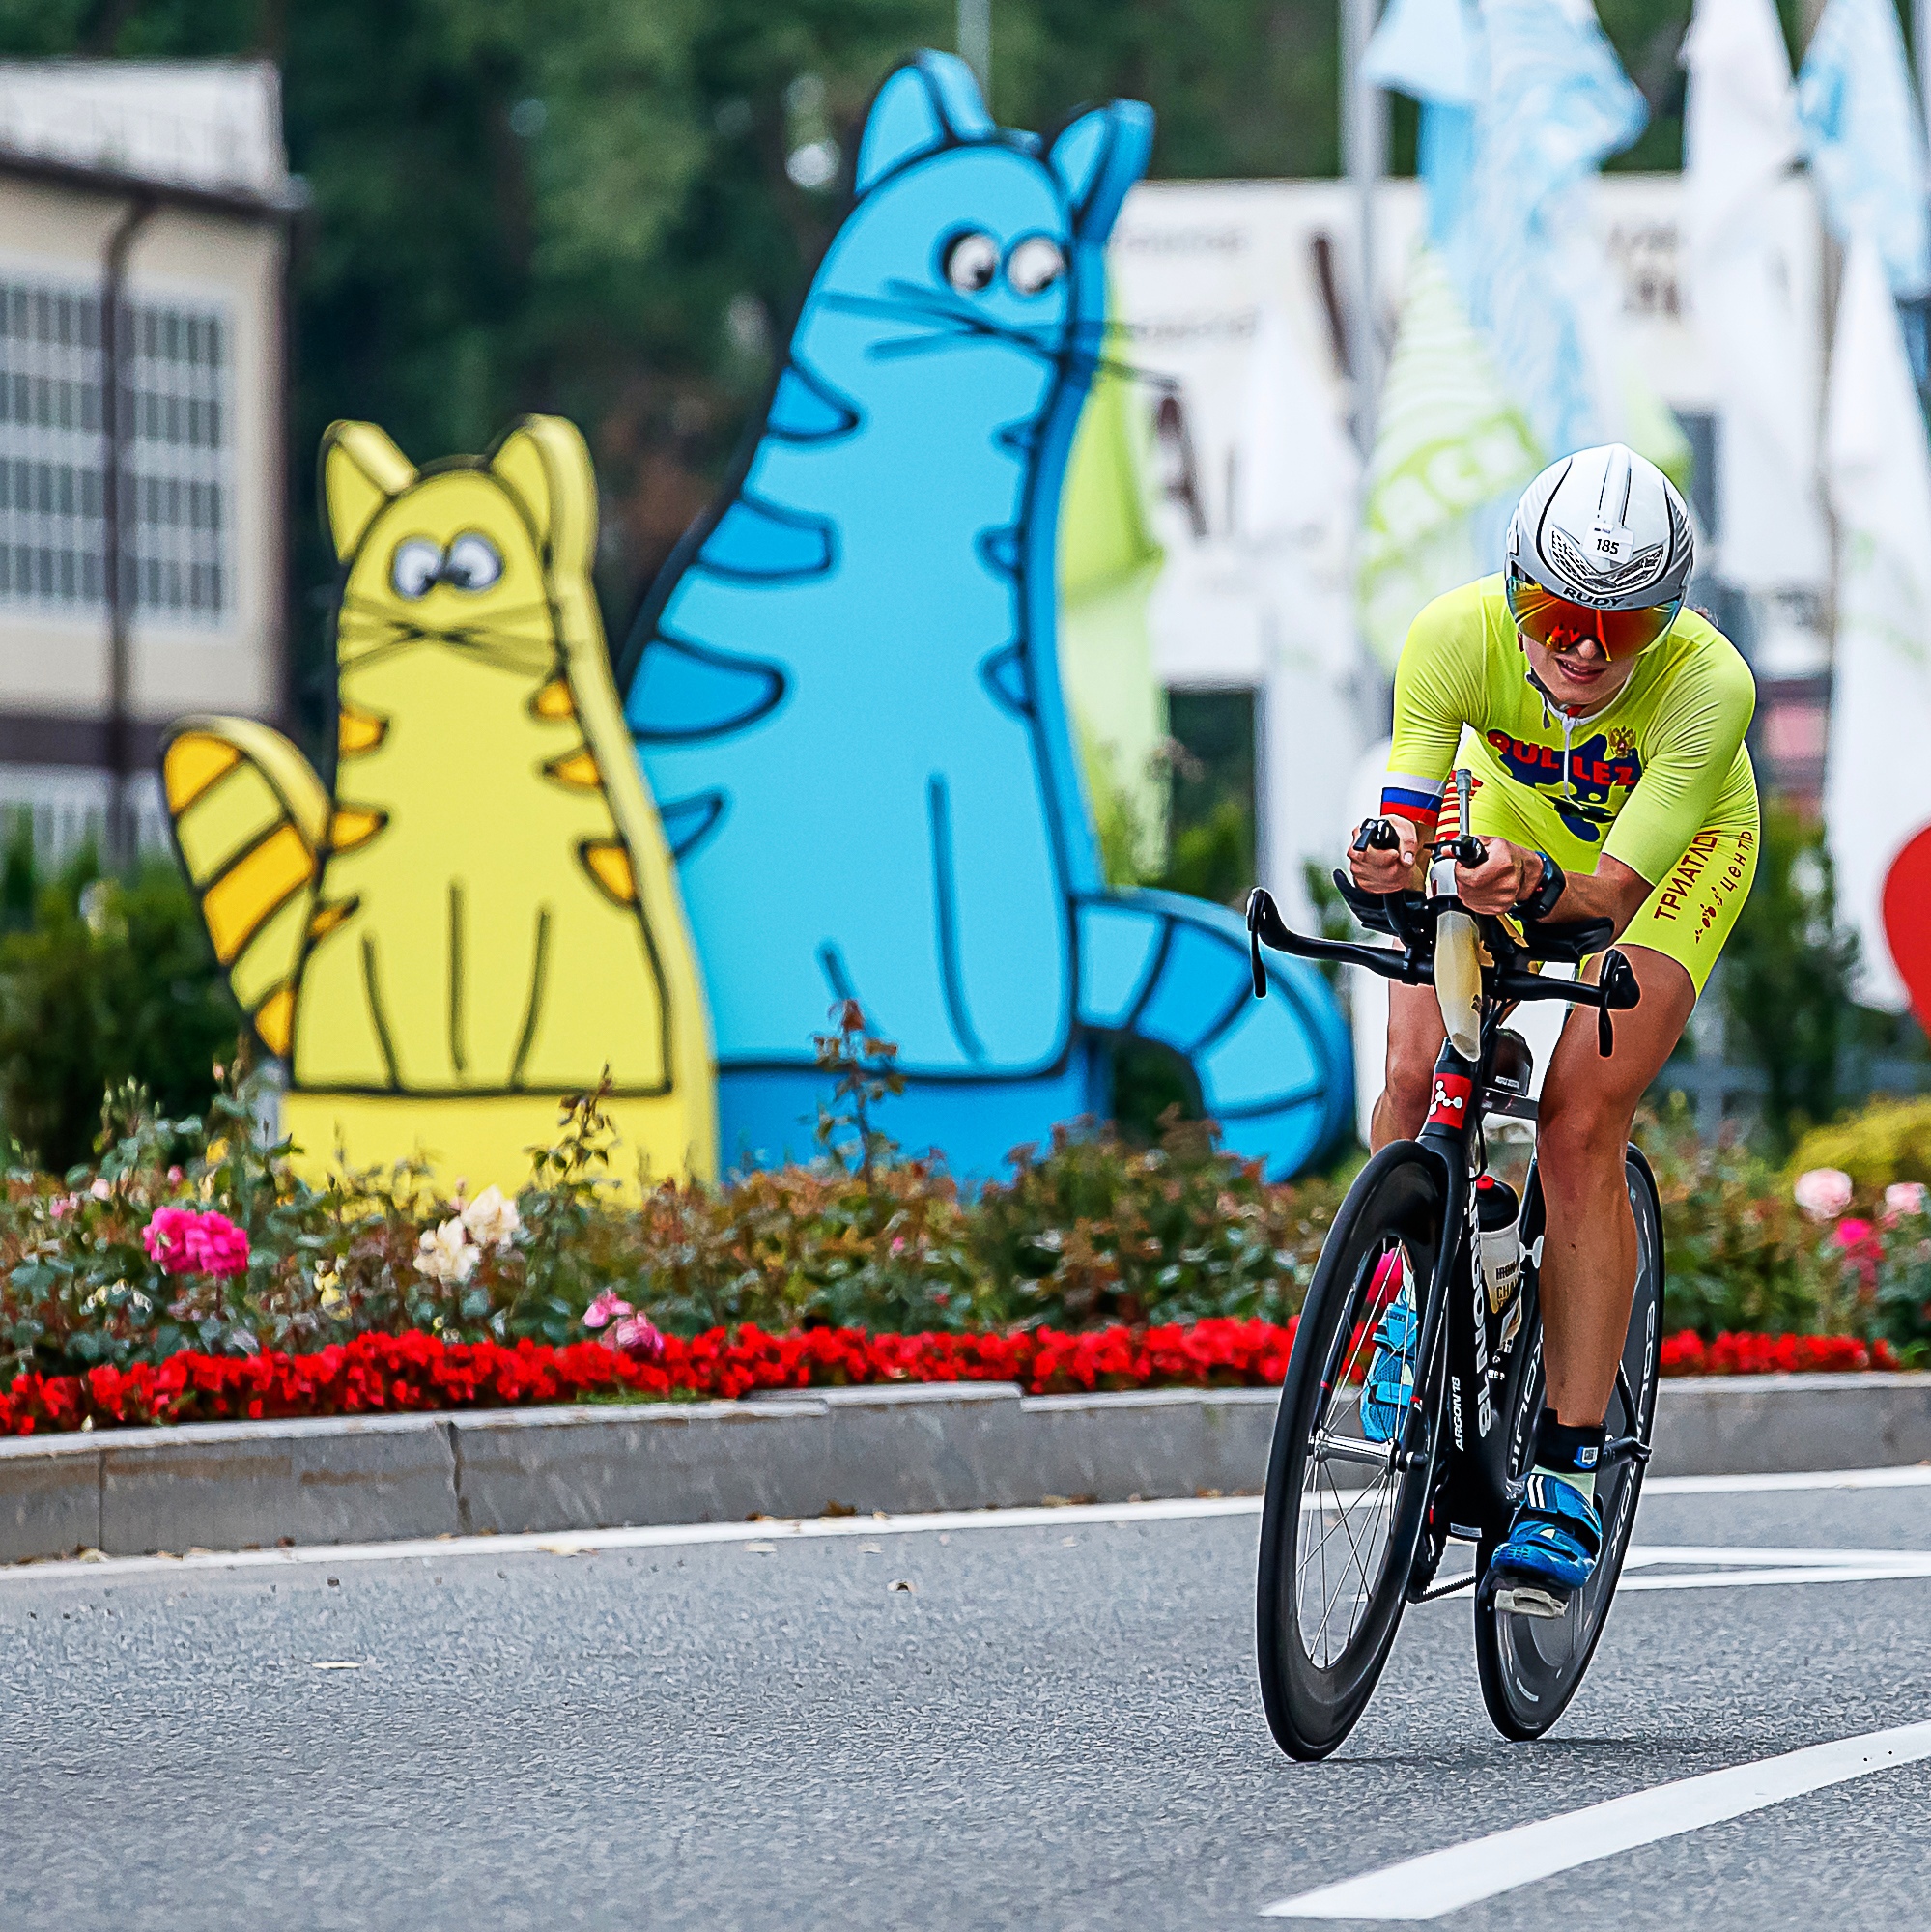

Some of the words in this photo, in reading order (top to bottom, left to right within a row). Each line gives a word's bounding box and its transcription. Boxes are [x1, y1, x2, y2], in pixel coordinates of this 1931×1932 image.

[1596, 538, 1620, 555] 185
[1563, 586, 1625, 607] RUDY
[1451, 1376, 1461, 1393] 18
[1477, 1371, 1491, 1438] 18
[1451, 1393, 1464, 1452] ARGON
